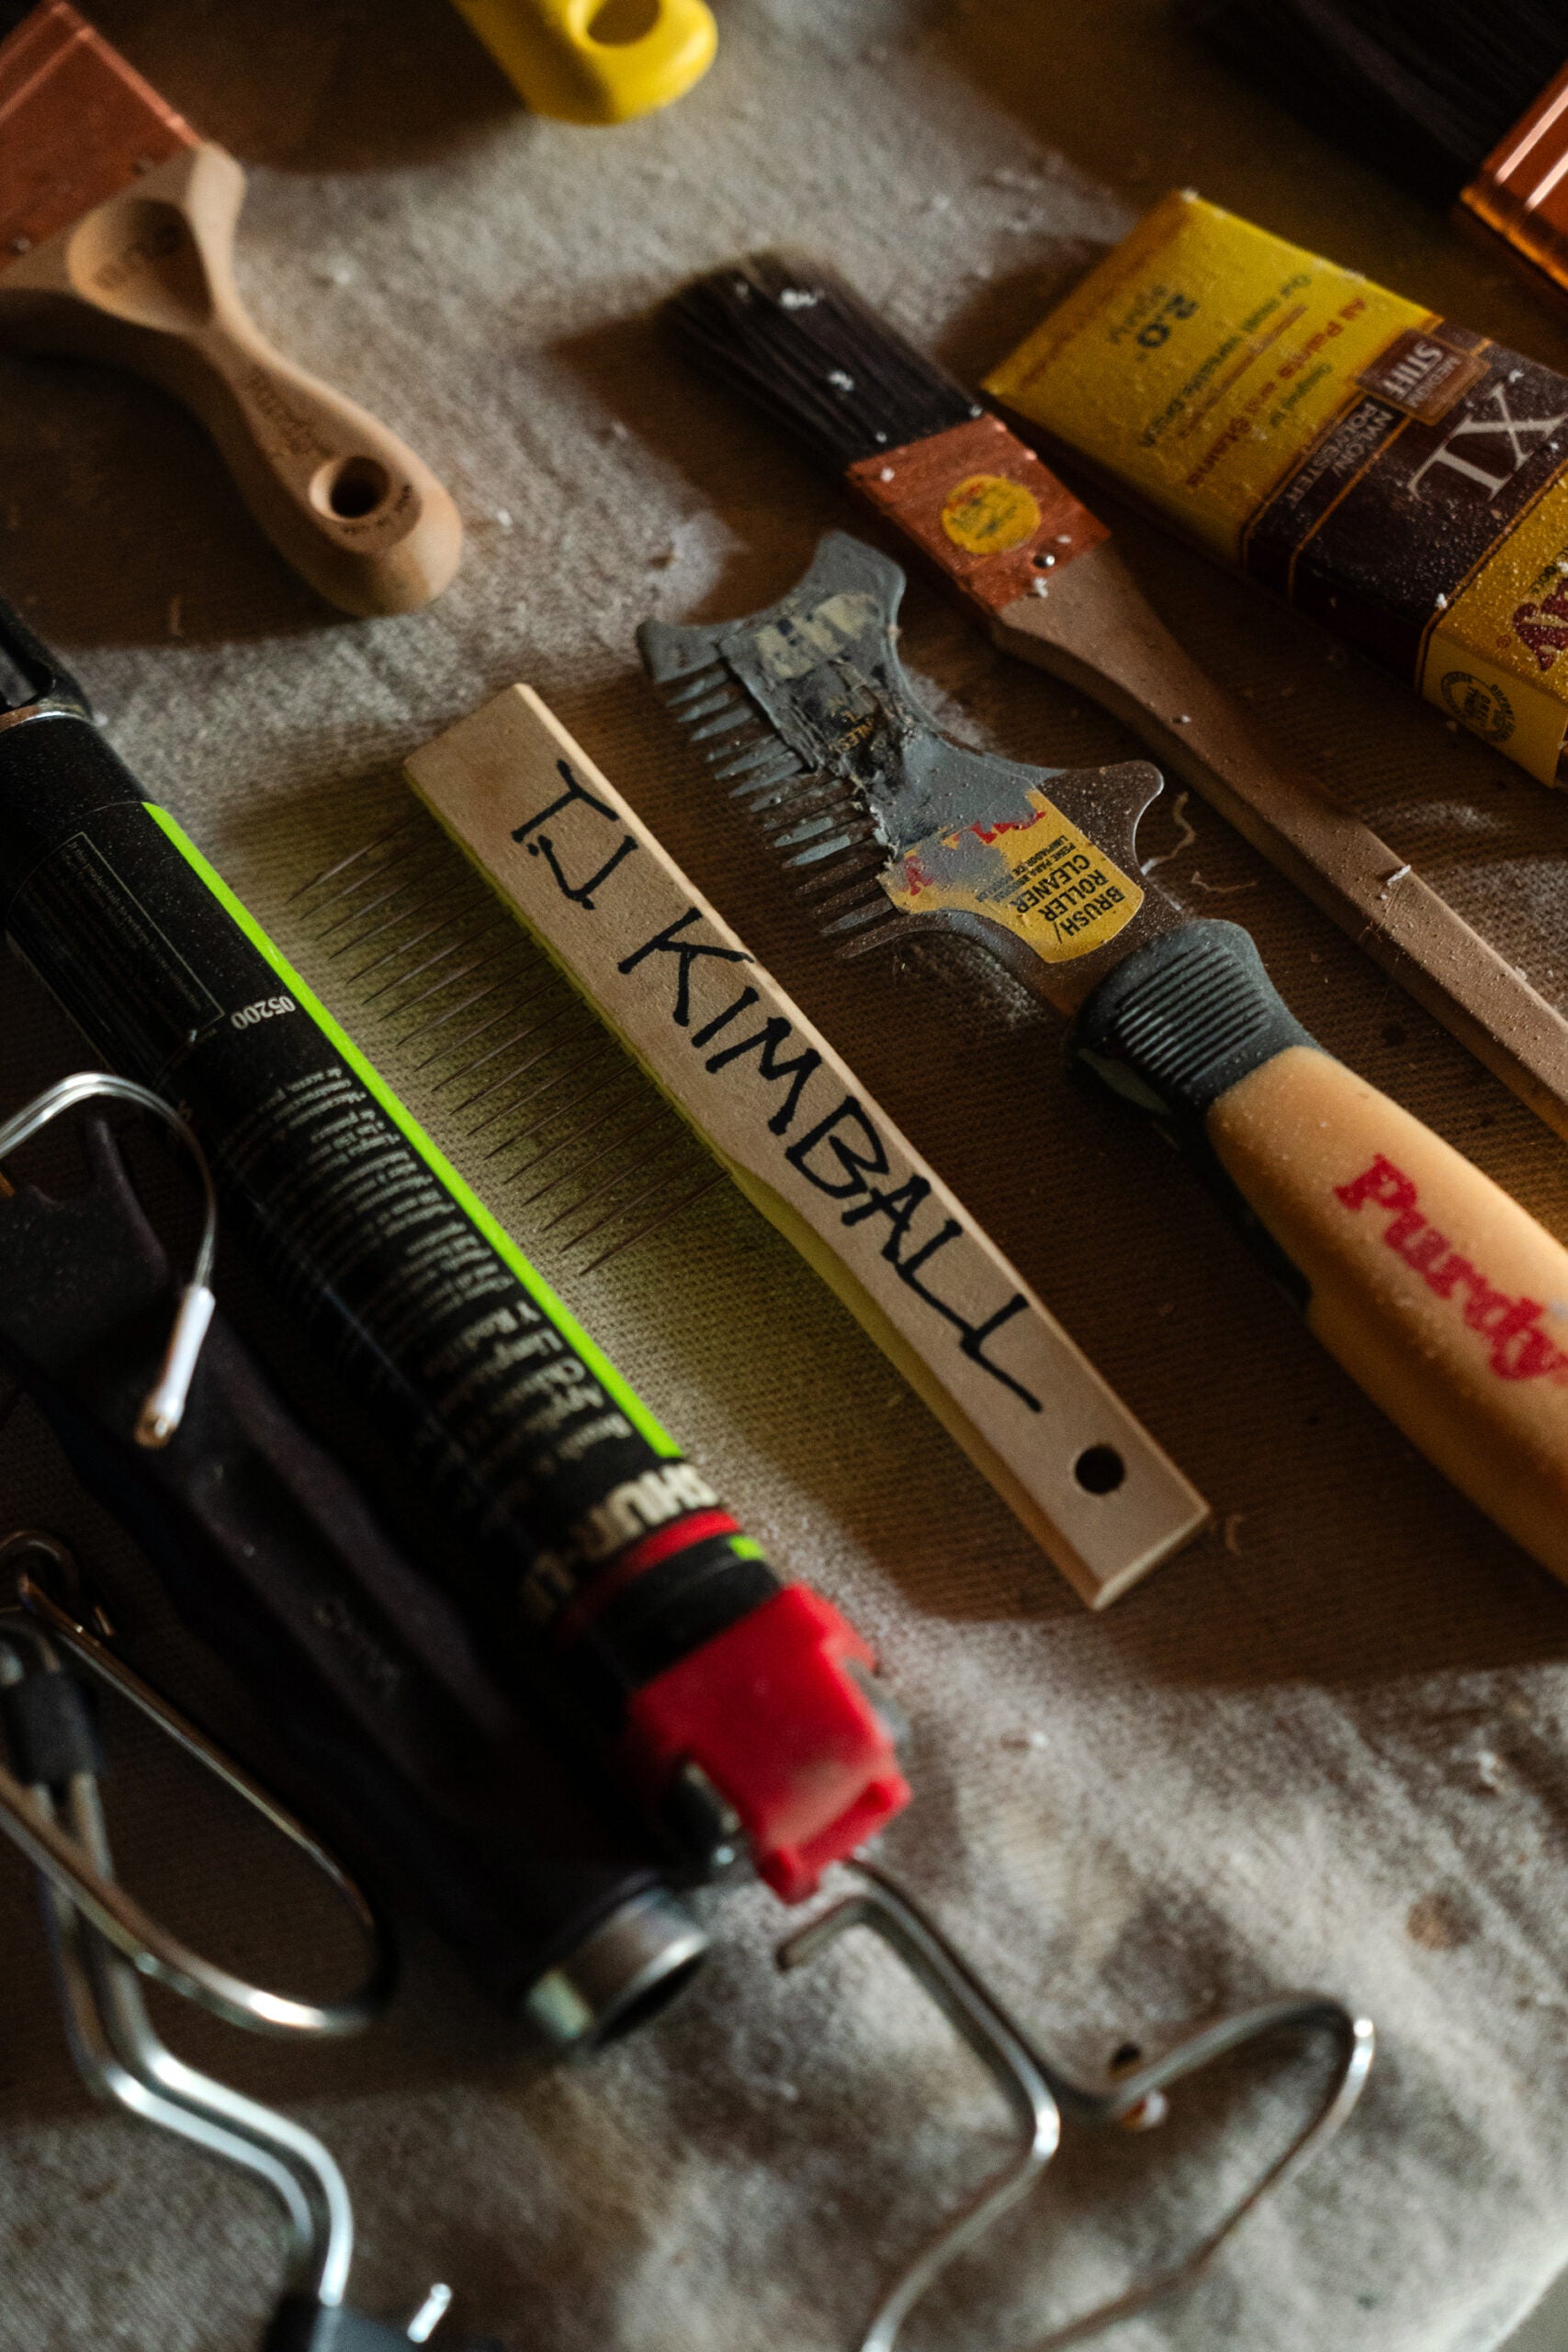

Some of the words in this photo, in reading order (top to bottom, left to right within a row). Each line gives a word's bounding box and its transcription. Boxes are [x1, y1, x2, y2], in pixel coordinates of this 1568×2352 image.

[1380, 340, 1441, 401] STIFF
[1405, 353, 1460, 410] MEDIUM
[1284, 401, 1377, 509] POLYESTER
[1404, 382, 1567, 503] XL
[1010, 852, 1091, 915] CLEANER
[1011, 865, 1025, 876] DE
[1029, 858, 1052, 877] PARA
[1037, 868, 1108, 923] ROLLER
[1052, 885, 1125, 944] BRUSH/
[228, 990, 297, 1032] 05200
[618, 907, 1043, 1413] KIMBALL
[1333, 1152, 1568, 1386] Purdy
